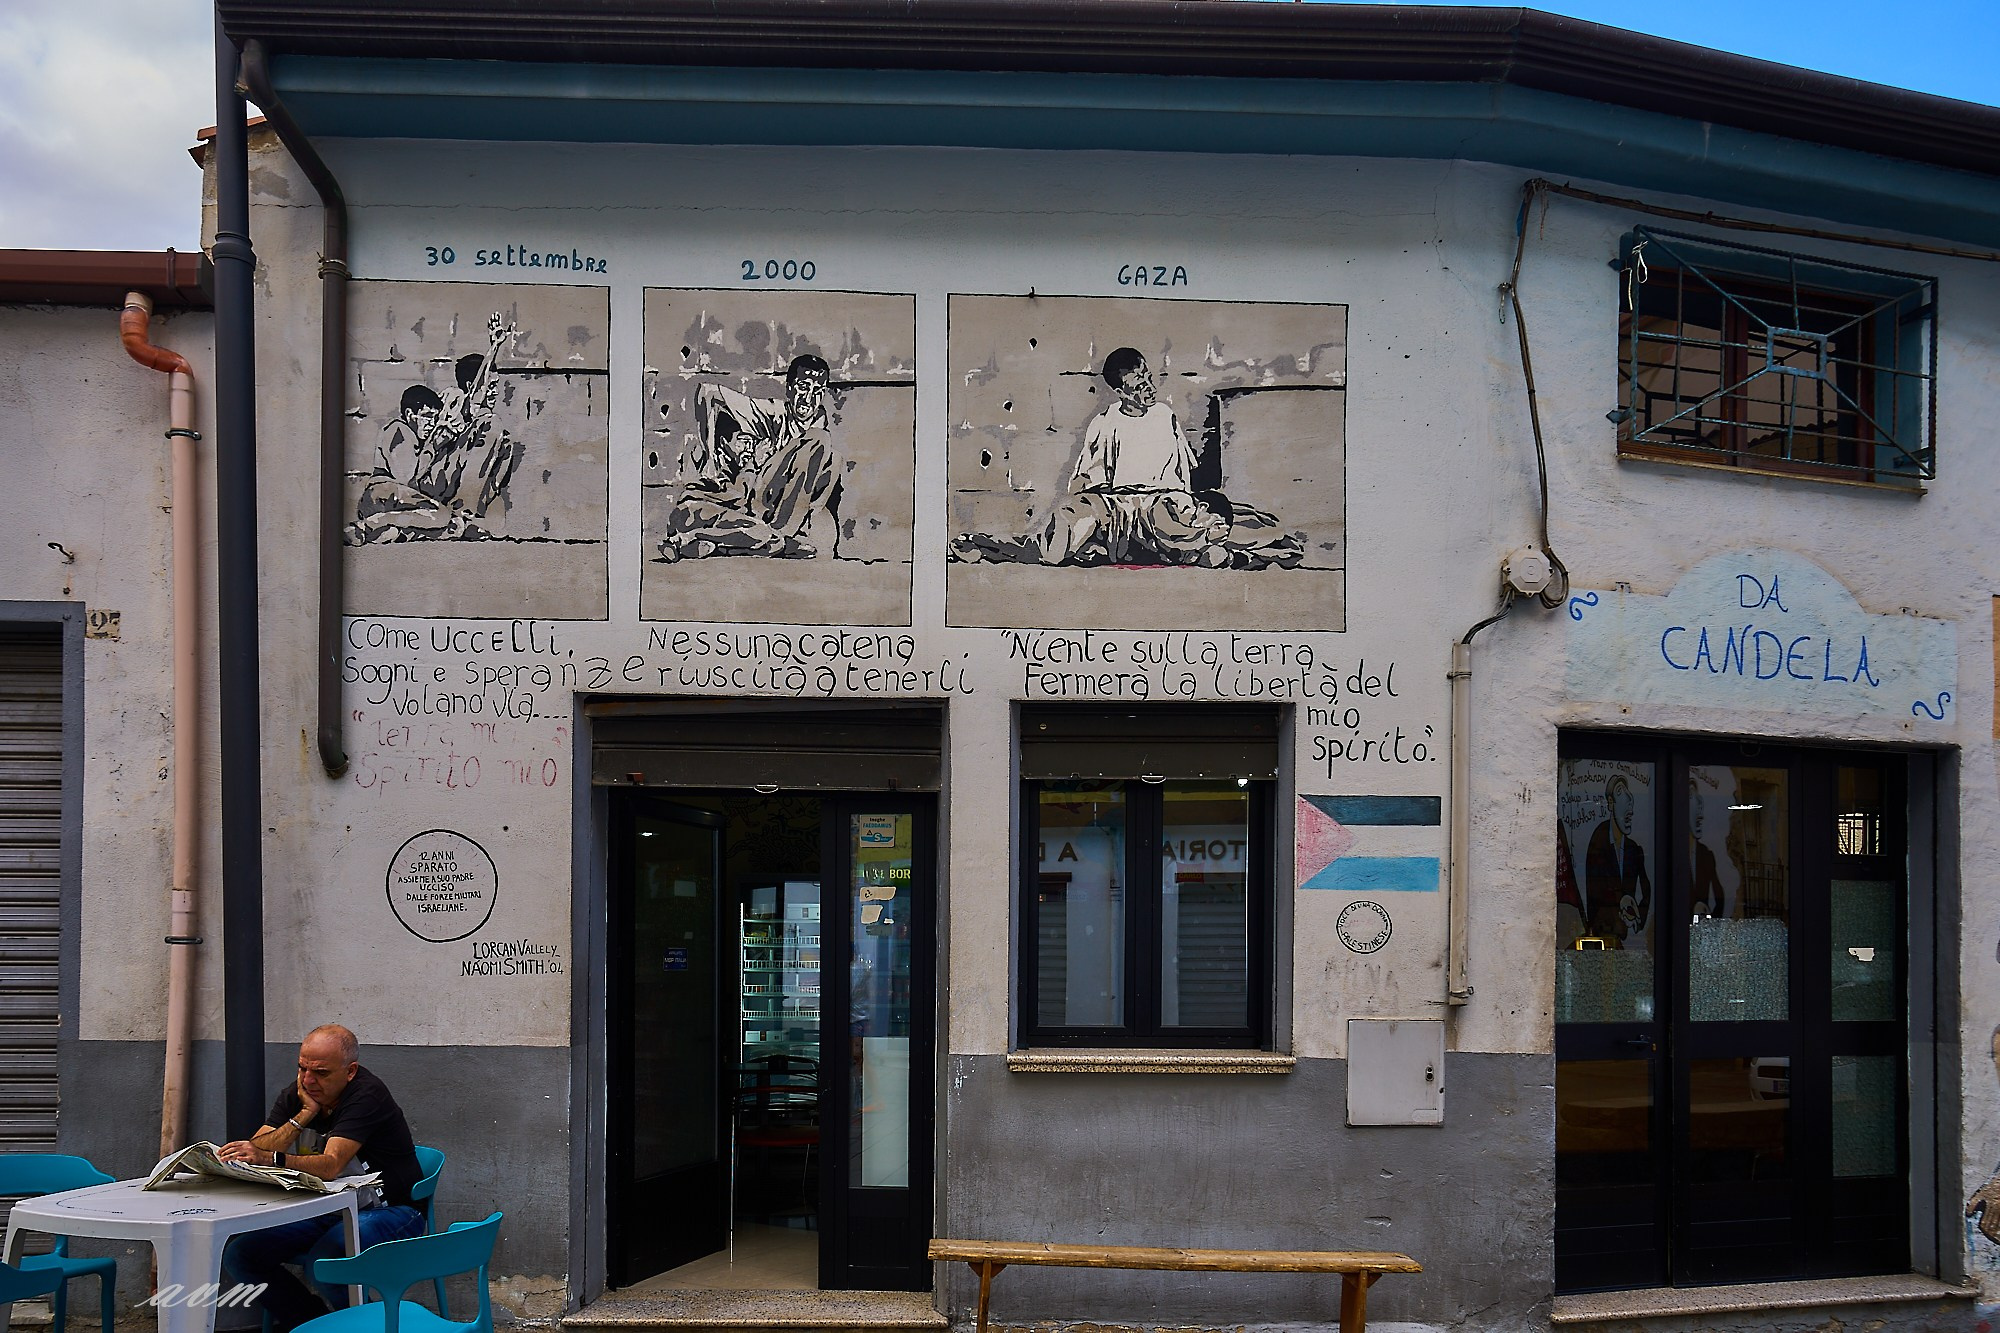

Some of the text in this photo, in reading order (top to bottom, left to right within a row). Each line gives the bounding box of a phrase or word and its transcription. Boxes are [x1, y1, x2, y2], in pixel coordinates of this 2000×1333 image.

[425, 244, 608, 274] 30 settembre
[741, 259, 816, 281] 2000
[1118, 264, 1188, 286] GAZA
[1737, 574, 1789, 612] DA
[648, 626, 915, 666] Nessuna catena
[1130, 633, 1219, 671] sulla
[1230, 633, 1315, 671] terra
[1661, 624, 1880, 687] CANDELA
[343, 656, 418, 704] Sogni
[433, 666, 446, 683] e
[814, 665, 837, 696] a
[846, 653, 976, 695] tenerli
[1024, 659, 1399, 704] Fermerà la libertà del
[393, 684, 483, 716] Volano
[1307, 701, 1361, 729] mio
[409, 861, 458, 874] SPARATO
[431, 850, 455, 861] ANNI
[397, 872, 475, 884] ASSIEME A SUO PADRE
[419, 882, 455, 892] UCCISO
[406, 890, 482, 902] DALLE FORZE MILITARI
[472, 941, 517, 959] LORCAN
[1341, 930, 1389, 951] PALESTINESE
